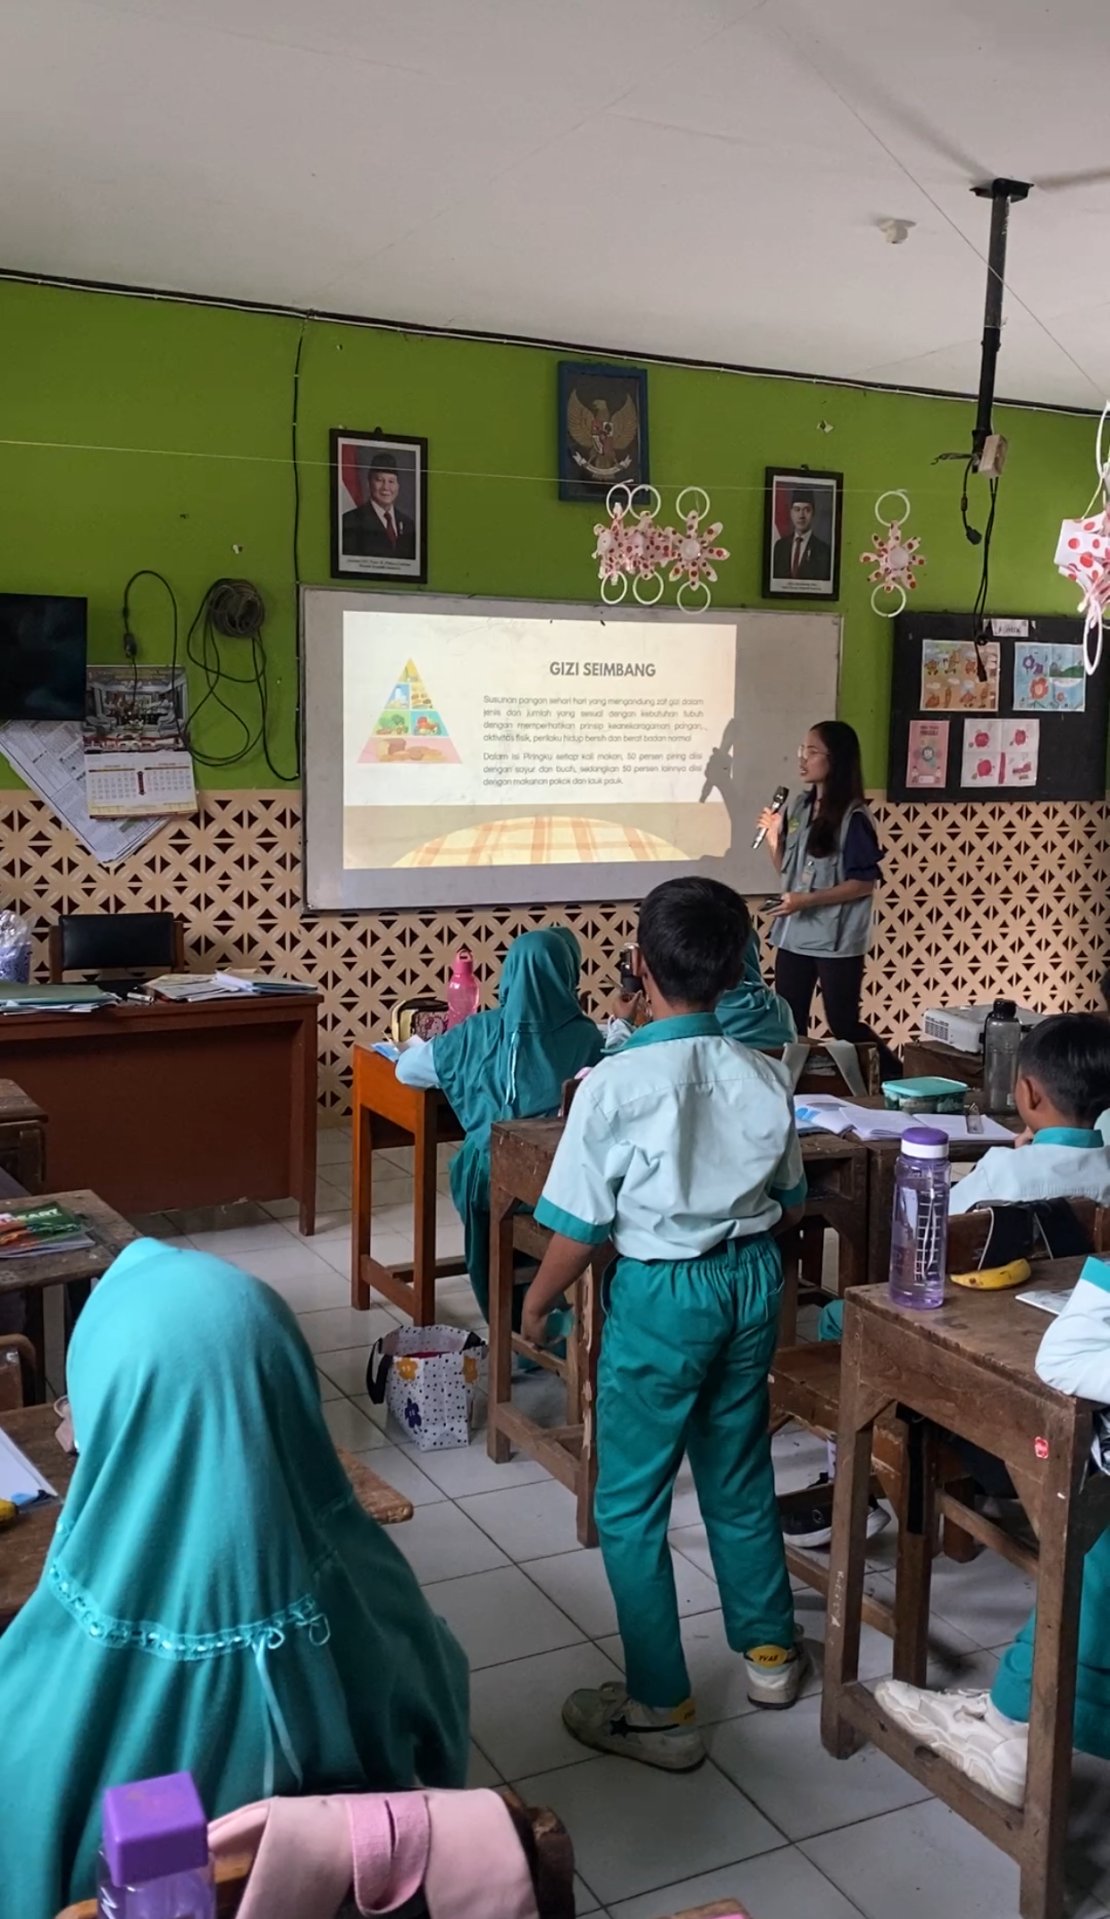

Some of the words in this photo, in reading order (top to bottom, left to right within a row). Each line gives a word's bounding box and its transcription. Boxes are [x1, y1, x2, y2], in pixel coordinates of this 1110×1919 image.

[550, 662, 579, 676] GIZI
[582, 662, 656, 677] SEIMBANG
[483, 695, 517, 704] Susunan
[519, 697, 548, 706] pangan
[573, 697, 587, 705] hari
[588, 698, 606, 706] yang
[607, 698, 655, 707] mengandung
[506, 709, 522, 717] dan
[526, 709, 552, 718] jumlah
[556, 710, 575, 718] yang
[608, 710, 637, 719] dengan
[683, 710, 704, 718] tubuh
[483, 721, 513, 730] dengan
[517, 722, 575, 730] memperhatikan
[563, 734, 584, 743] hidup
[483, 752, 509, 761] Dalam
[627, 752, 637, 760] 50
[638, 753, 664, 762] persen
[483, 765, 513, 774] dengan
[515, 766, 535, 774] sayur
[538, 765, 554, 773] dan
[634, 766, 659, 774] persen
[483, 778, 512, 787] dengan
[513, 778, 548, 786] makanan
